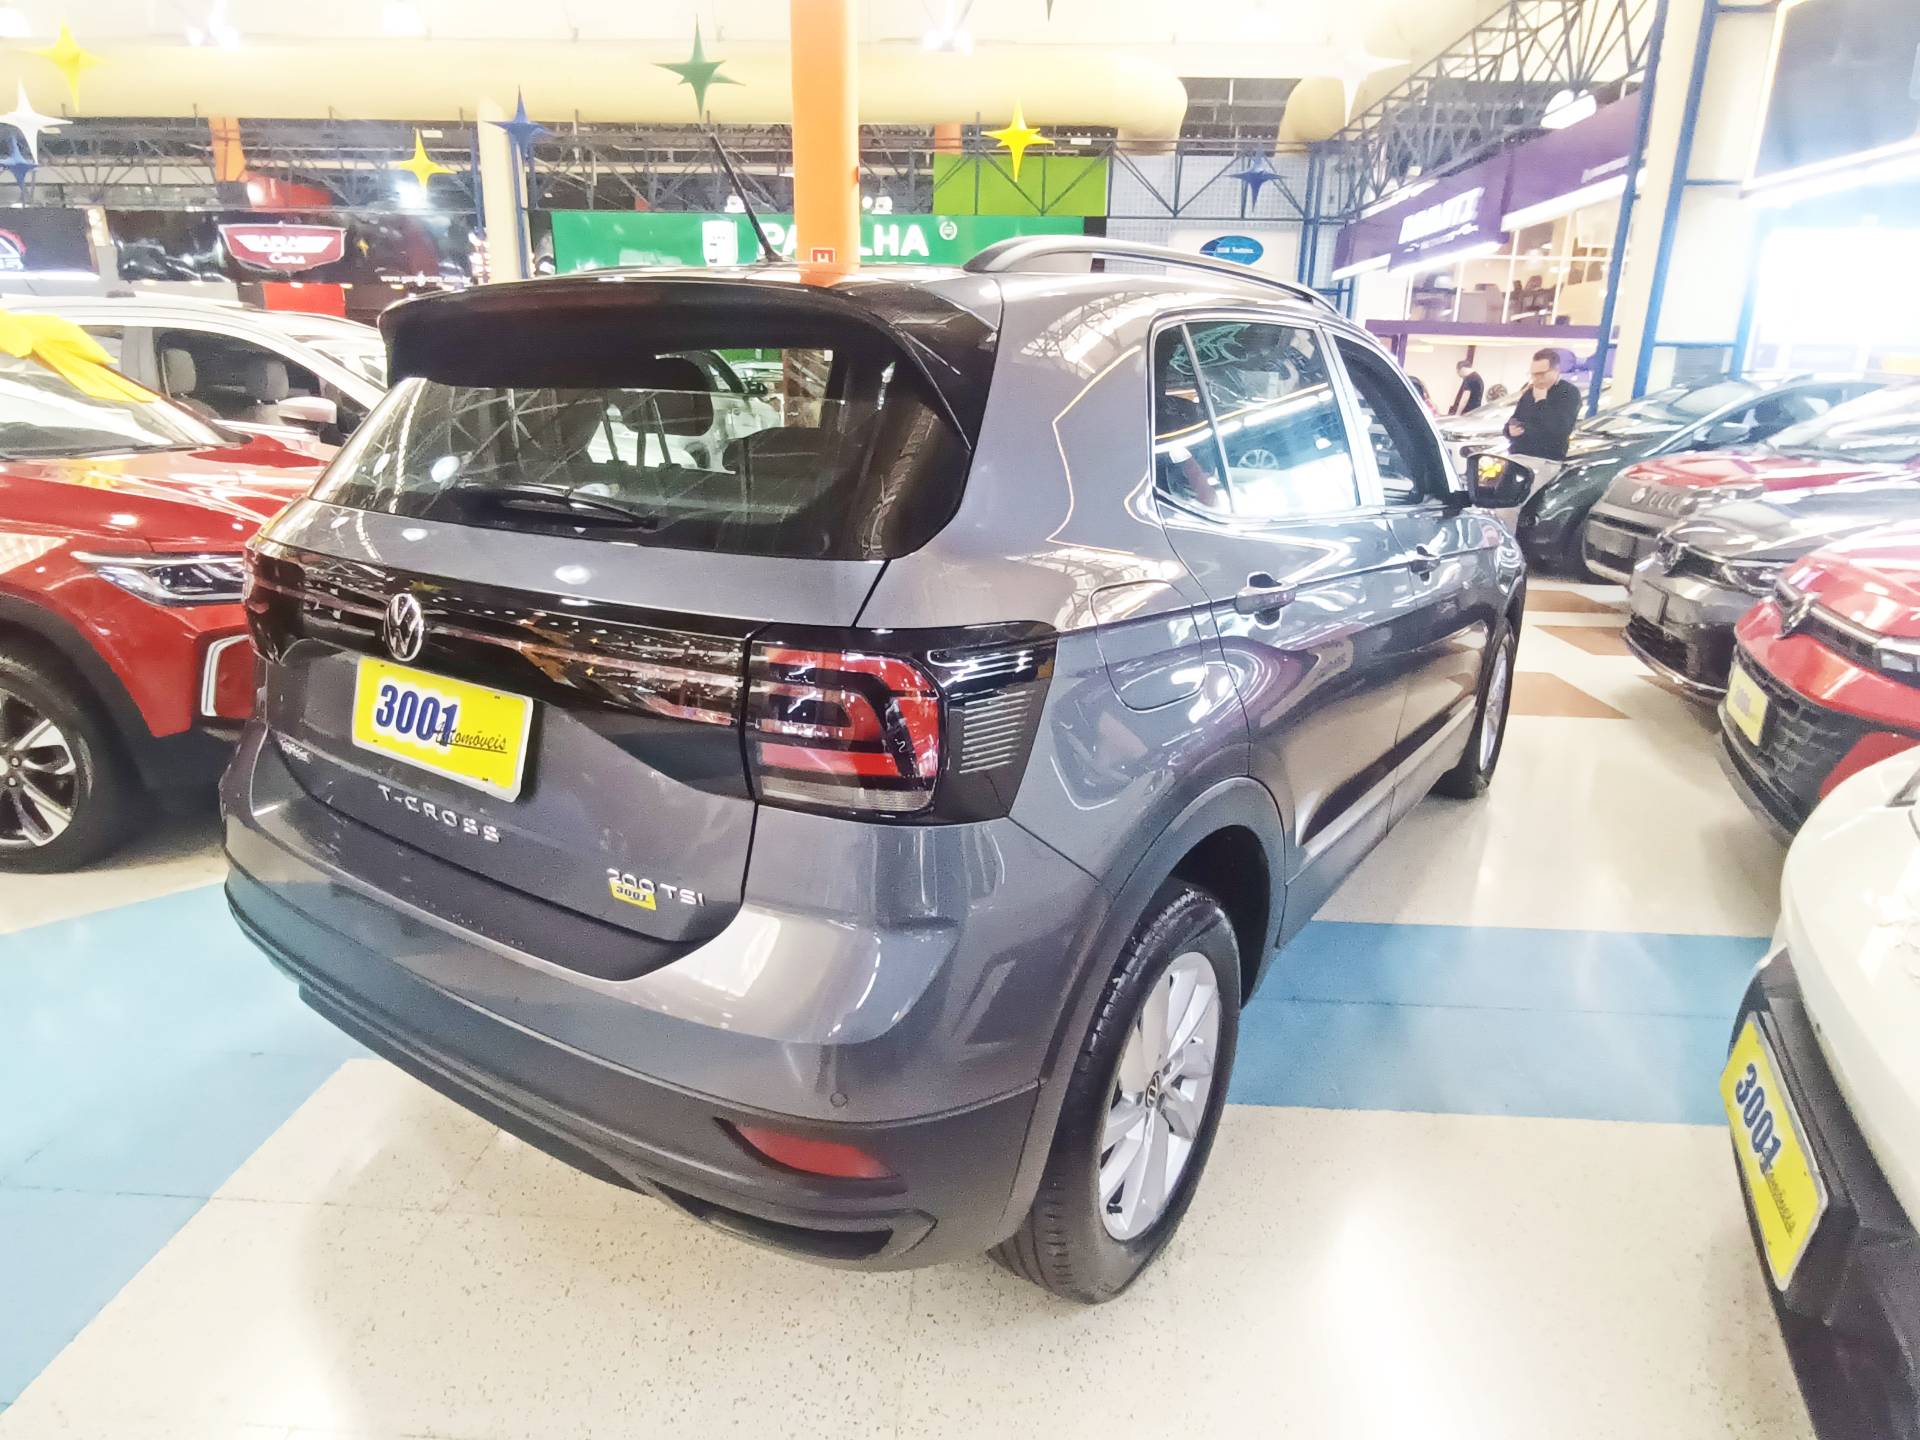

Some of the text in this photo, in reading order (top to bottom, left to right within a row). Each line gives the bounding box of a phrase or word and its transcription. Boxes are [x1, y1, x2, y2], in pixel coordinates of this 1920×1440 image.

[375, 684, 459, 747] 3001
[433, 722, 508, 751] Atomóveis
[377, 784, 501, 843] T-CROSS
[606, 867, 705, 907] 200 TSI
[616, 886, 648, 902] 3001
[1735, 1063, 1782, 1175] 3001
